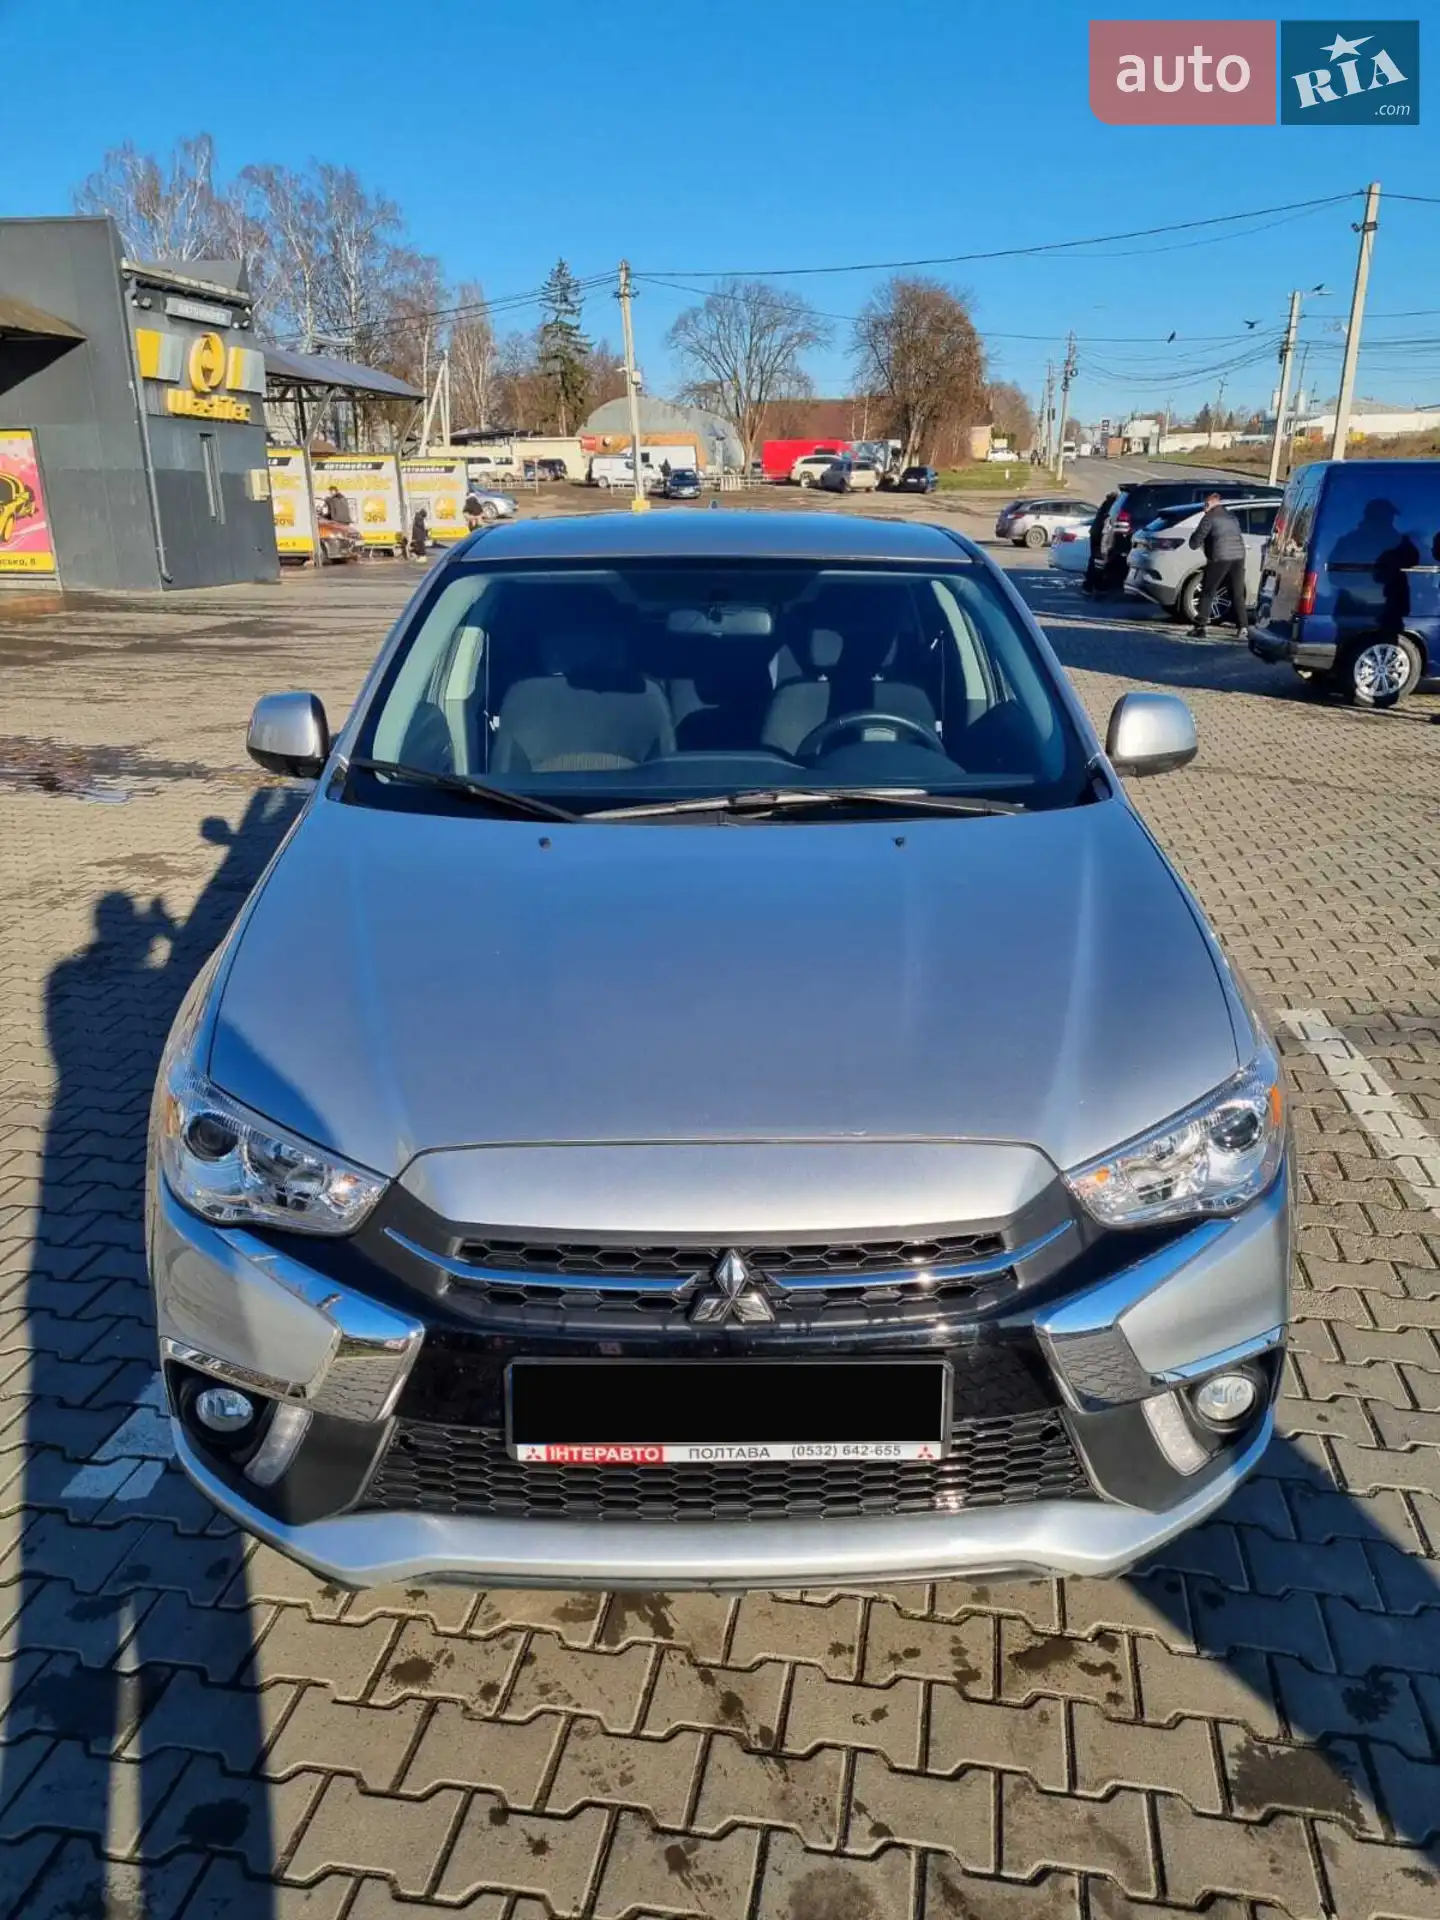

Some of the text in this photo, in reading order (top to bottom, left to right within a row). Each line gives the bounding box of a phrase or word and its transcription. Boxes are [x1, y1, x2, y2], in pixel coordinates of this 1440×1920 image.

[550, 1444, 902, 1462] ІНТЕРАВТО ПОЛТАВА (0532) 642-655
